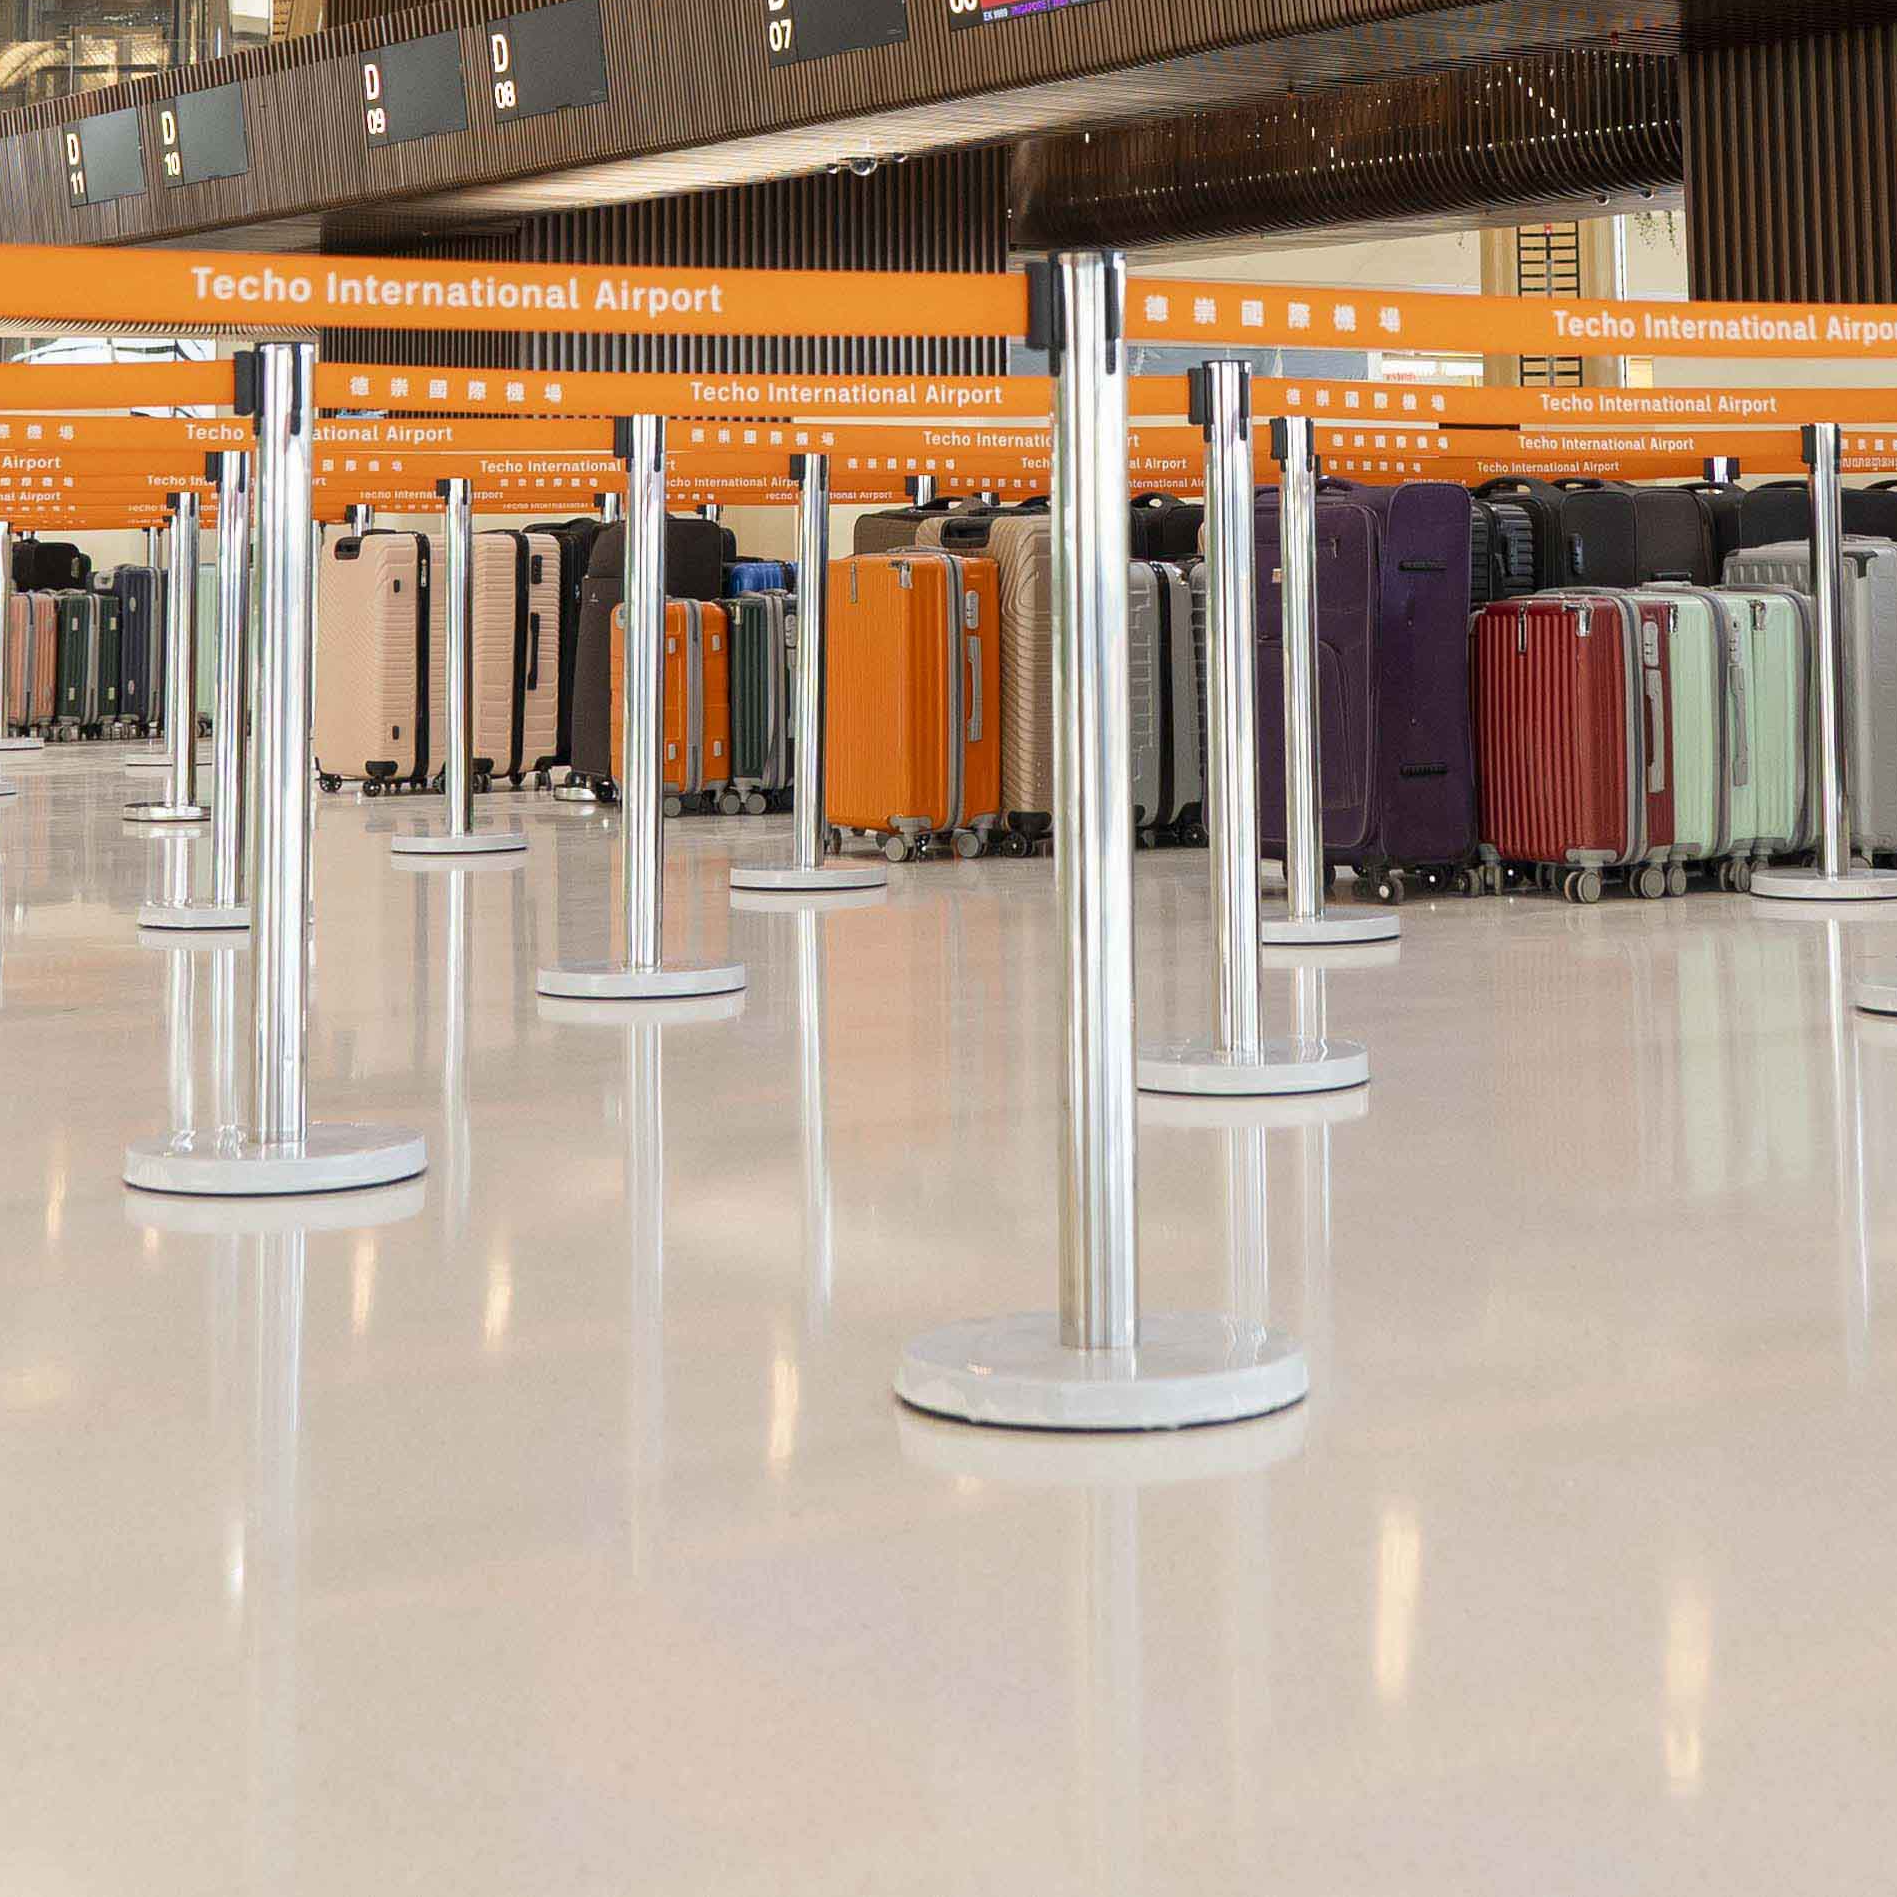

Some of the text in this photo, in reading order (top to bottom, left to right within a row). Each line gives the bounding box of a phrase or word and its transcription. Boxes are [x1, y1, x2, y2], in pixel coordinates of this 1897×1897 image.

[769, 18, 792, 52] 07
[491, 34, 508, 73] D
[364, 63, 380, 100] D
[494, 80, 516, 109] 08
[161, 111, 176, 145] D
[367, 108, 385, 134] 09
[66, 133, 80, 165] D
[164, 151, 181, 176] 10
[70, 171, 85, 195] 11
[191, 267, 722, 318] Techo International Airport
[1553, 310, 1635, 338] Techo
[1644, 313, 1817, 340] International
[350, 376, 562, 403] 德崇國際機場
[691, 381, 1002, 407] Techo International Airport
[1540, 393, 1776, 416] Techo International Airport
[186, 423, 452, 444] Techo ational Airport
[923, 431, 971, 446] Techo
[1518, 435, 1694, 452] Techo International Airport
[2, 456, 60, 471] Airport
[480, 459, 621, 472] Techo International
[1021, 457, 1050, 468] Tech
[1145, 458, 1186, 471] Airport
[1478, 461, 1619, 473] Techo International Airport
[147, 475, 186, 486] Techo
[695, 477, 767, 487] International
